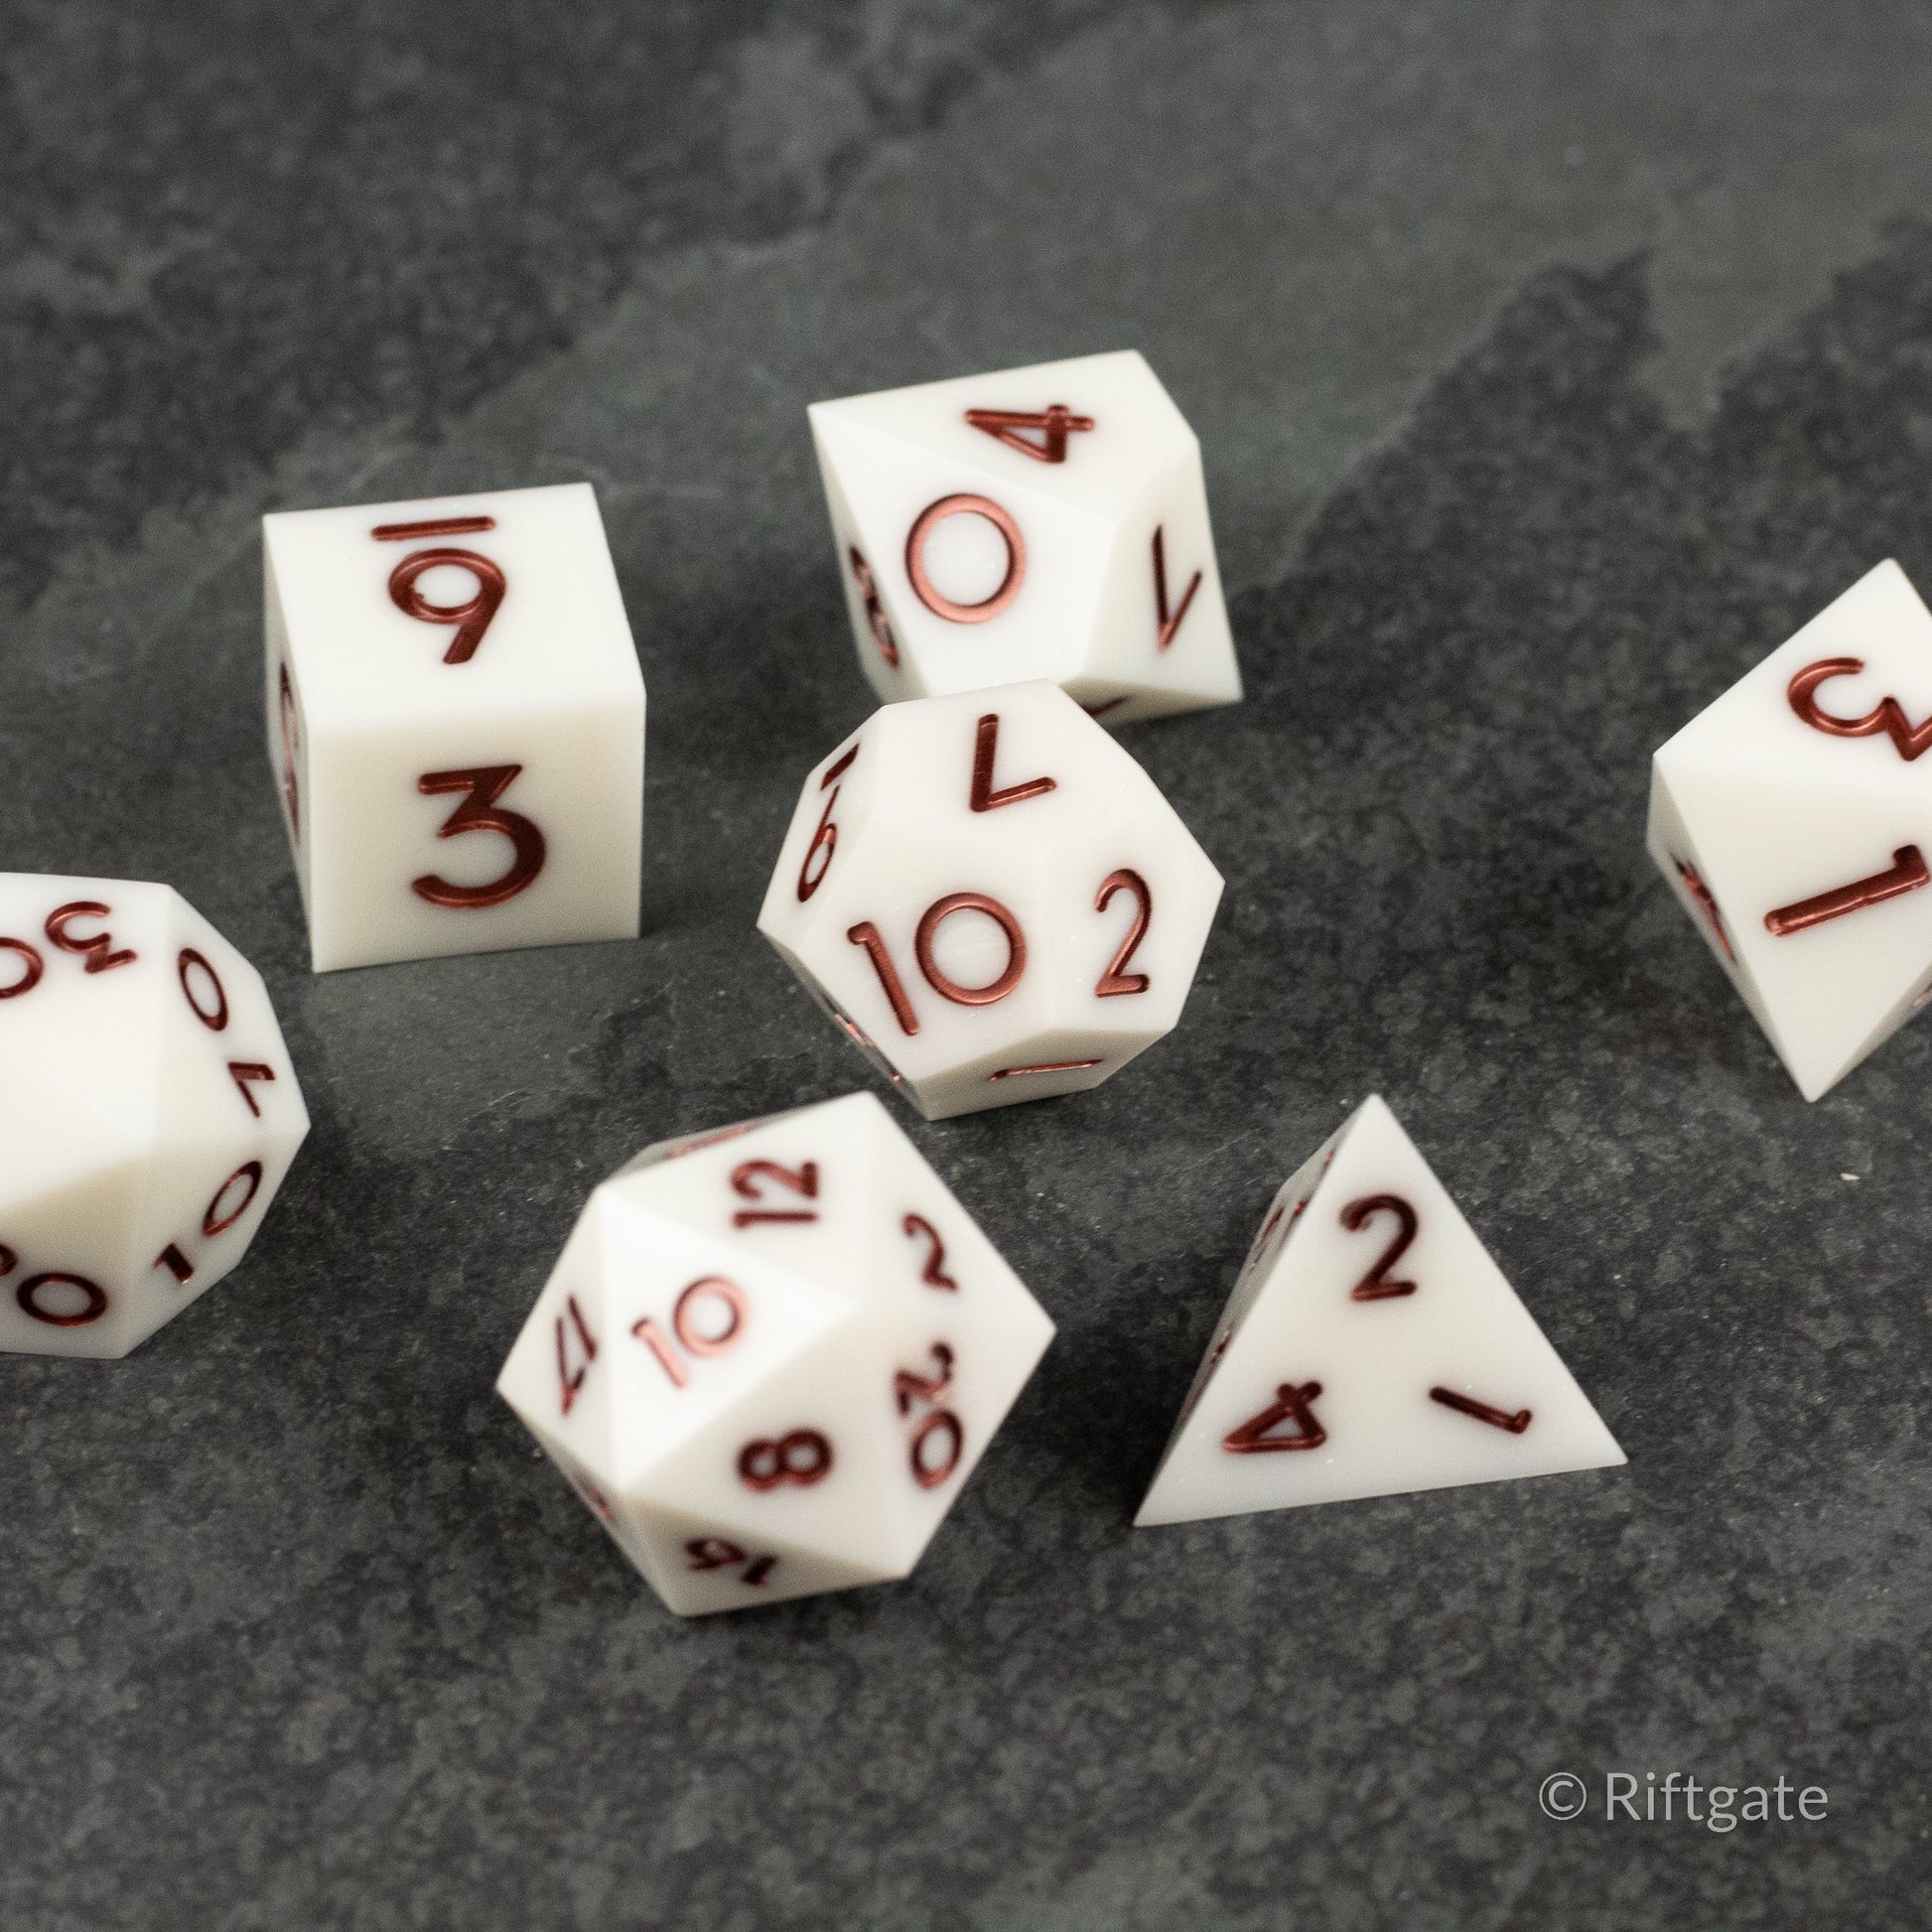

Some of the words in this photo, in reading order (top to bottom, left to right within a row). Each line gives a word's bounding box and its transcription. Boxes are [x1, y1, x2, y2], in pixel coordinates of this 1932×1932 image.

[963, 405, 1095, 464] 4
[1787, 656, 1932, 762] 3
[411, 763, 547, 910] 3
[1093, 868, 1153, 998] 2
[1763, 843, 1930, 938] 1
[847, 892, 1028, 1035] 10
[154, 1157, 263, 1286] 10
[730, 1159, 821, 1232] 12
[1339, 1193, 1418, 1303] 2
[901, 1211, 960, 1293] 2
[630, 1275, 750, 1390] 10
[736, 1427, 837, 1494] 8
[891, 1339, 965, 1491] 20
[1223, 1381, 1326, 1455] 4
[1430, 1385, 1533, 1436] 1
